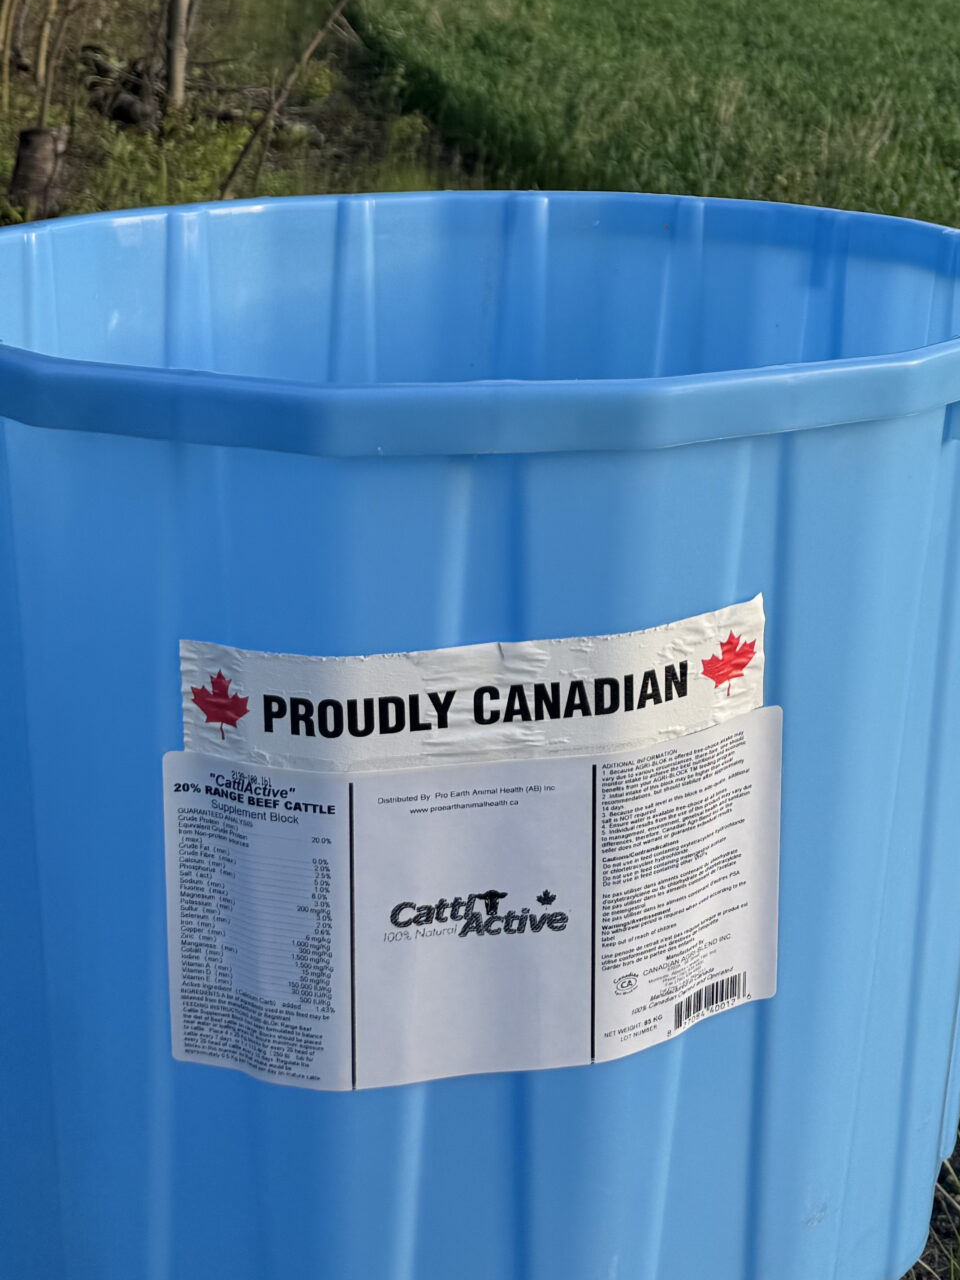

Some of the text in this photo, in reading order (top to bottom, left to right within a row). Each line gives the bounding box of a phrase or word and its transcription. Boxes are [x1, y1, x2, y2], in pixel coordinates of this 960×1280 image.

[263, 660, 688, 738] PROUDLY CANADIAN
[609, 766, 635, 776] Because
[173, 782, 336, 816] 20% RANGE BEEF CATTLE
[377, 794, 419, 804] Distributed
[420, 793, 431, 802] By
[434, 791, 448, 800] Pro
[450, 789, 470, 798] Earth
[472, 787, 498, 797] Animal
[499, 785, 524, 795] Health
[525, 784, 542, 794] (AB)
[211, 799, 299, 825] Supplement Block
[610, 804, 624, 813] days
[619, 814, 633, 822] NOT
[458, 907, 569, 938] Active
[383, 924, 458, 943] 100% Natural
[602, 935, 616, 943] label
[601, 941, 617, 949] Keep
[620, 979, 634, 989] CA
[603, 1029, 617, 1039] NET
[652, 1013, 664, 1024] KG
[620, 1024, 659, 1043] LOT NUMBER
